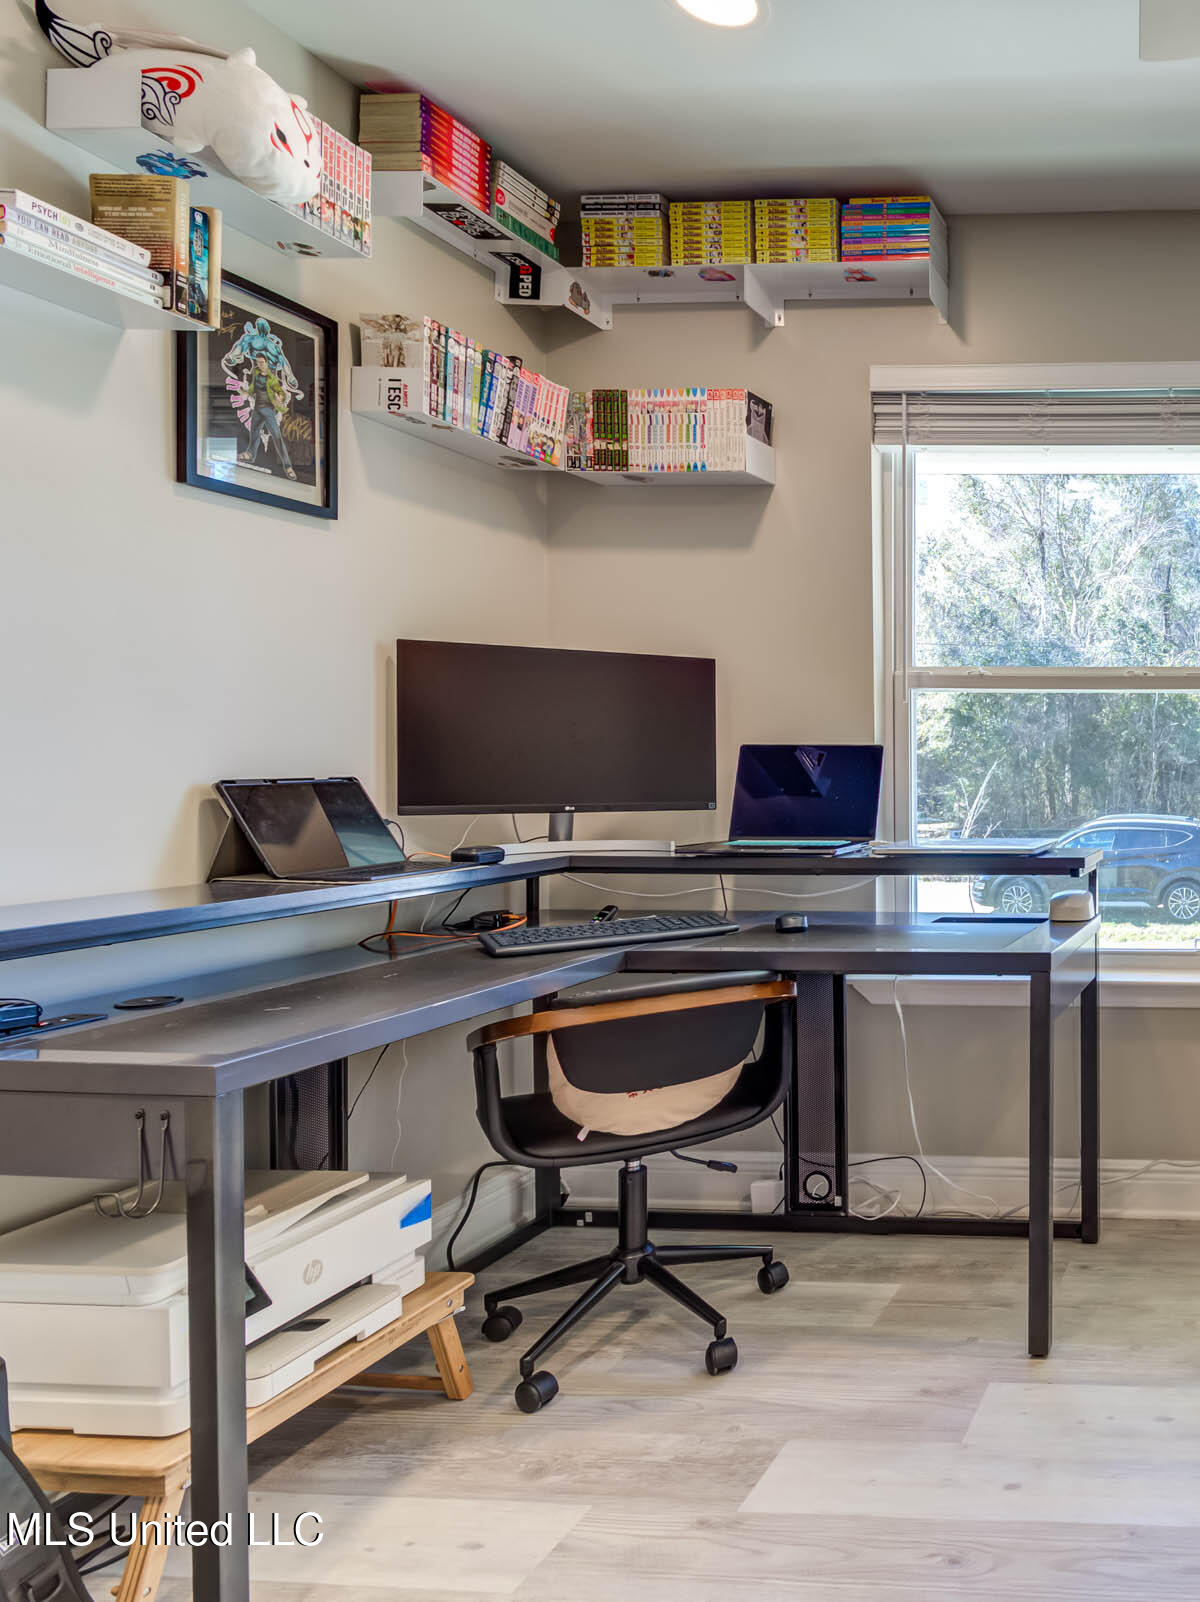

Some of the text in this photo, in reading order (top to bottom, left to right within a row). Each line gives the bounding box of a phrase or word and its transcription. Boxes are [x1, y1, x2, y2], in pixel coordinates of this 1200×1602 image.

[16, 214, 32, 226] YOU
[34, 220, 49, 233] CAN
[51, 228, 70, 243] READ
[303, 1258, 324, 1285] hp
